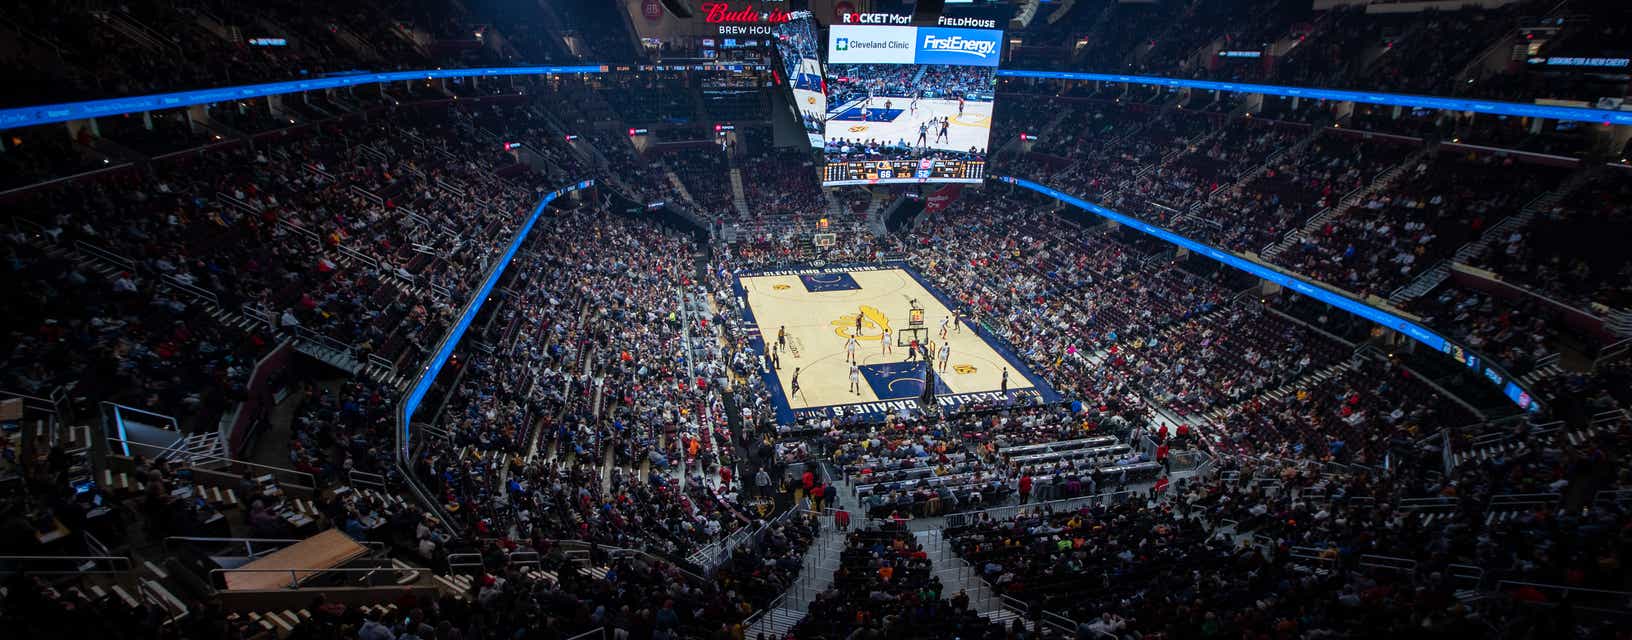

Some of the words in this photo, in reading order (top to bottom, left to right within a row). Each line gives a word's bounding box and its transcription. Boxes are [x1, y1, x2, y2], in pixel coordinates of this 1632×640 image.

[843, 13, 889, 23] ROCKET
[938, 16, 996, 28] FIELDHOUSE
[719, 26, 747, 34] BREW
[749, 26, 771, 34] HOU
[850, 40, 887, 49] Cleveland
[888, 40, 910, 50] Clinic
[924, 35, 993, 54] FirstEnergy
[763, 268, 819, 277] CLEVELAND
[832, 399, 917, 416] CAVALIES
